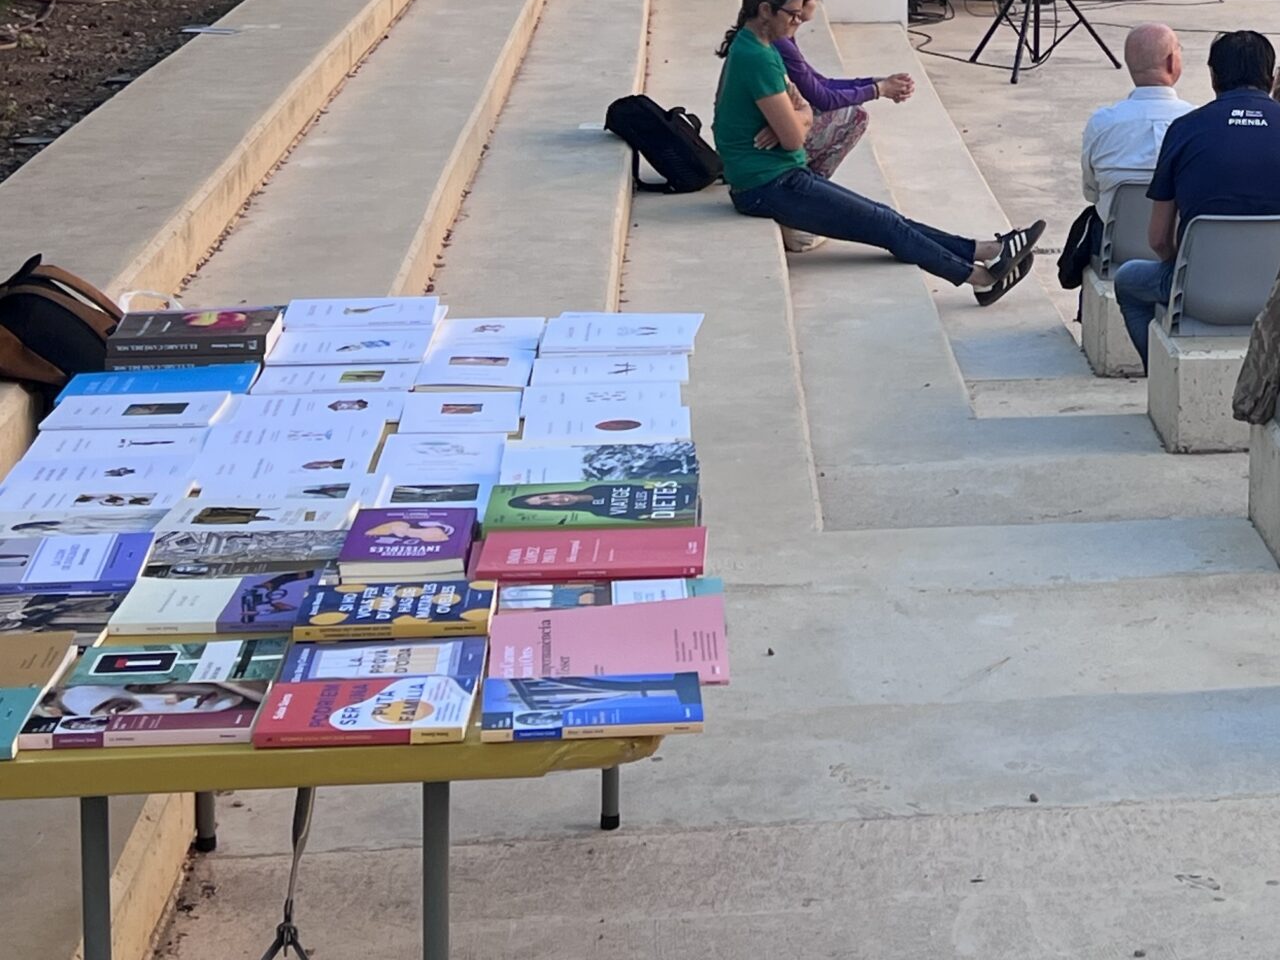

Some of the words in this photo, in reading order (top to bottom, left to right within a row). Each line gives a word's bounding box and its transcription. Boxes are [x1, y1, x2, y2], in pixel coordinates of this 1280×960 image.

[1228, 118, 1268, 126] PRENSA
[609, 487, 631, 515] VIATGE
[651, 481, 678, 519] DIETES
[369, 545, 441, 553] INVISIBLES
[362, 587, 380, 599] FER
[422, 583, 437, 594] LES
[343, 593, 358, 603] HO
[415, 595, 433, 618] MATAR
[436, 585, 456, 613] OVELLES
[339, 604, 354, 612] SI
[356, 599, 373, 619] VOLS
[347, 657, 364, 667] LA
[369, 649, 389, 674] PROVA
[371, 690, 395, 716] PUTA
[339, 707, 361, 725] SER
